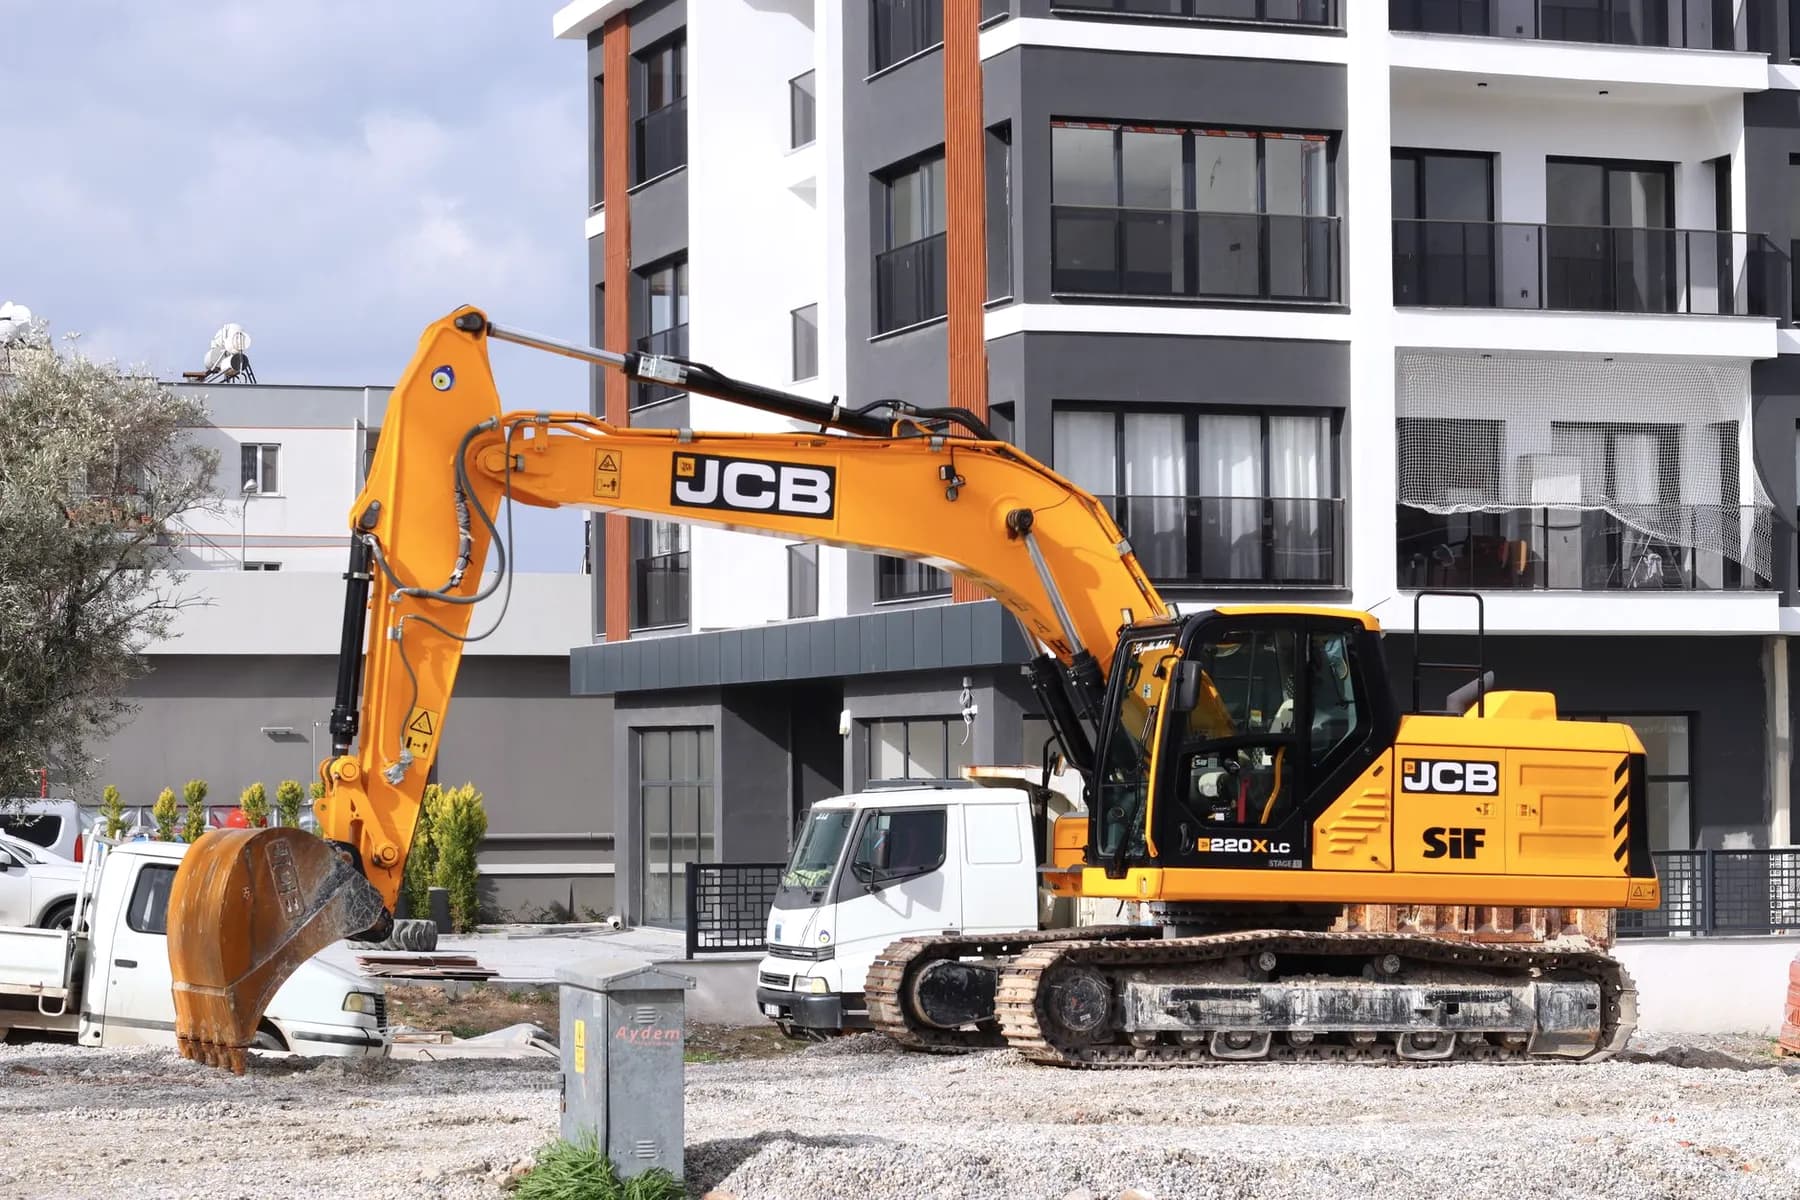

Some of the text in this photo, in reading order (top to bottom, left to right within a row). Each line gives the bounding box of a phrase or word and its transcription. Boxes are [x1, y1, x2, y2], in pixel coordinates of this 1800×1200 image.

[676, 459, 831, 514] JCB
[1404, 761, 1497, 793] JCB
[615, 1025, 681, 1042] Aydem
